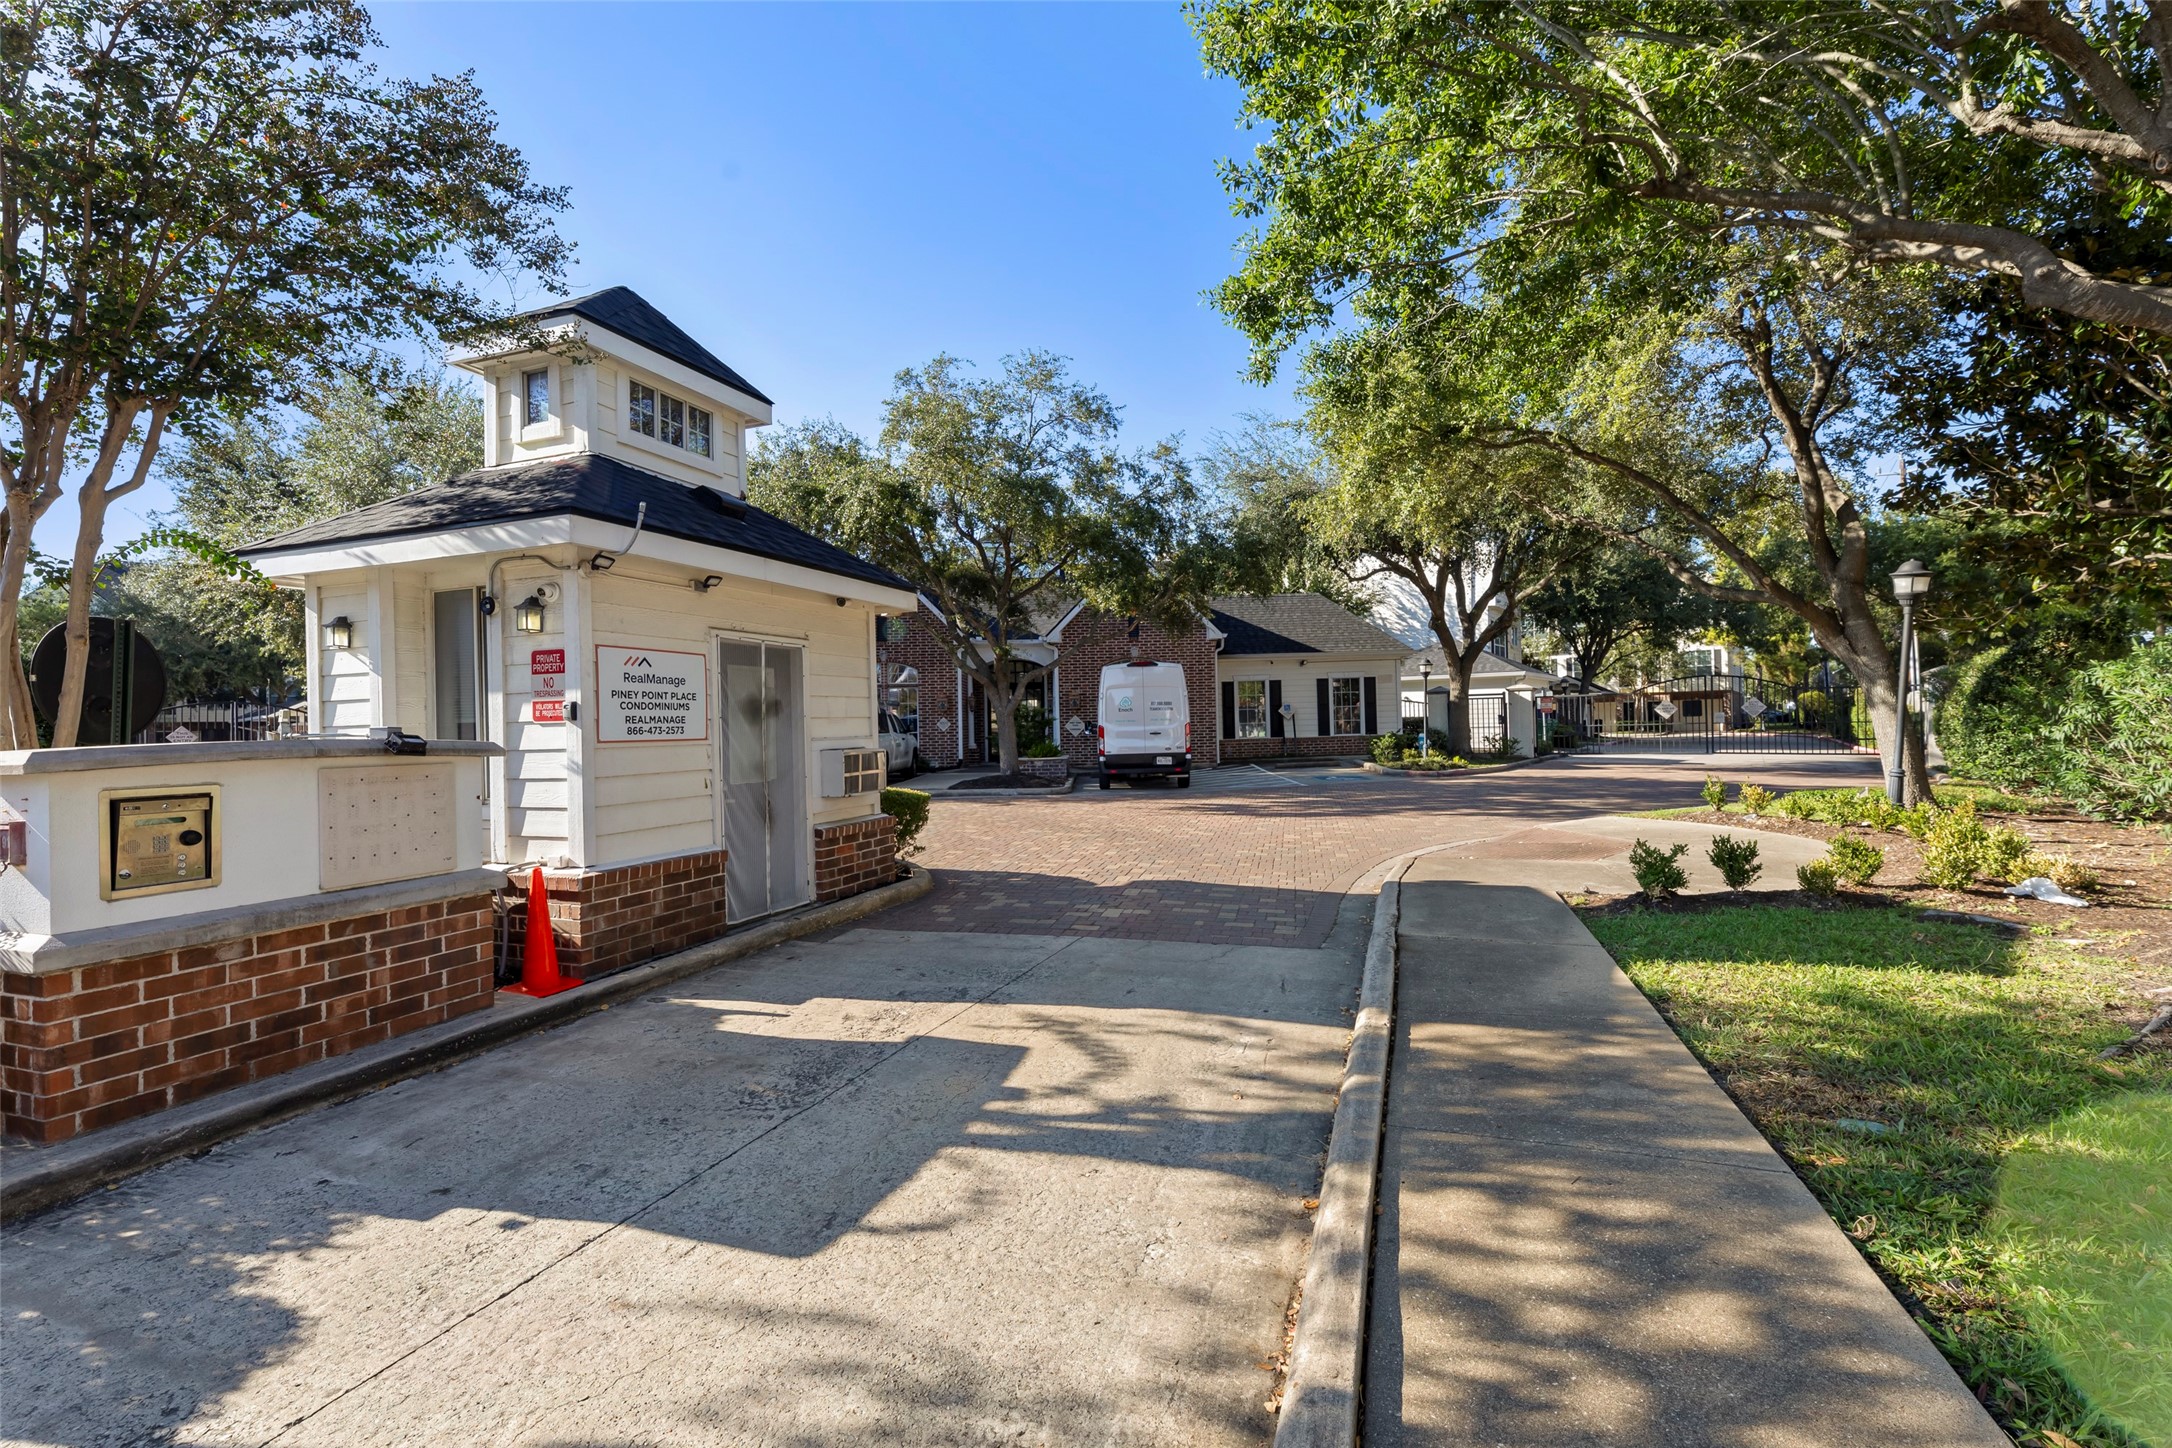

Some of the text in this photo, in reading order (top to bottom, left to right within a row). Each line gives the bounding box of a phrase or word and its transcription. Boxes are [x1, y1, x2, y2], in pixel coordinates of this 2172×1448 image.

[536, 654, 561, 663] PRIVATE
[533, 663, 564, 672] PROPERTY
[543, 677, 554, 688] NO
[623, 672, 686, 688] RealManage
[611, 690, 697, 701] PINEY POINT PLACE
[619, 701, 690, 711] CONDOMINIUMS
[625, 715, 686, 724] REALMANAGE
[626, 726, 685, 735] 866-473-2573
